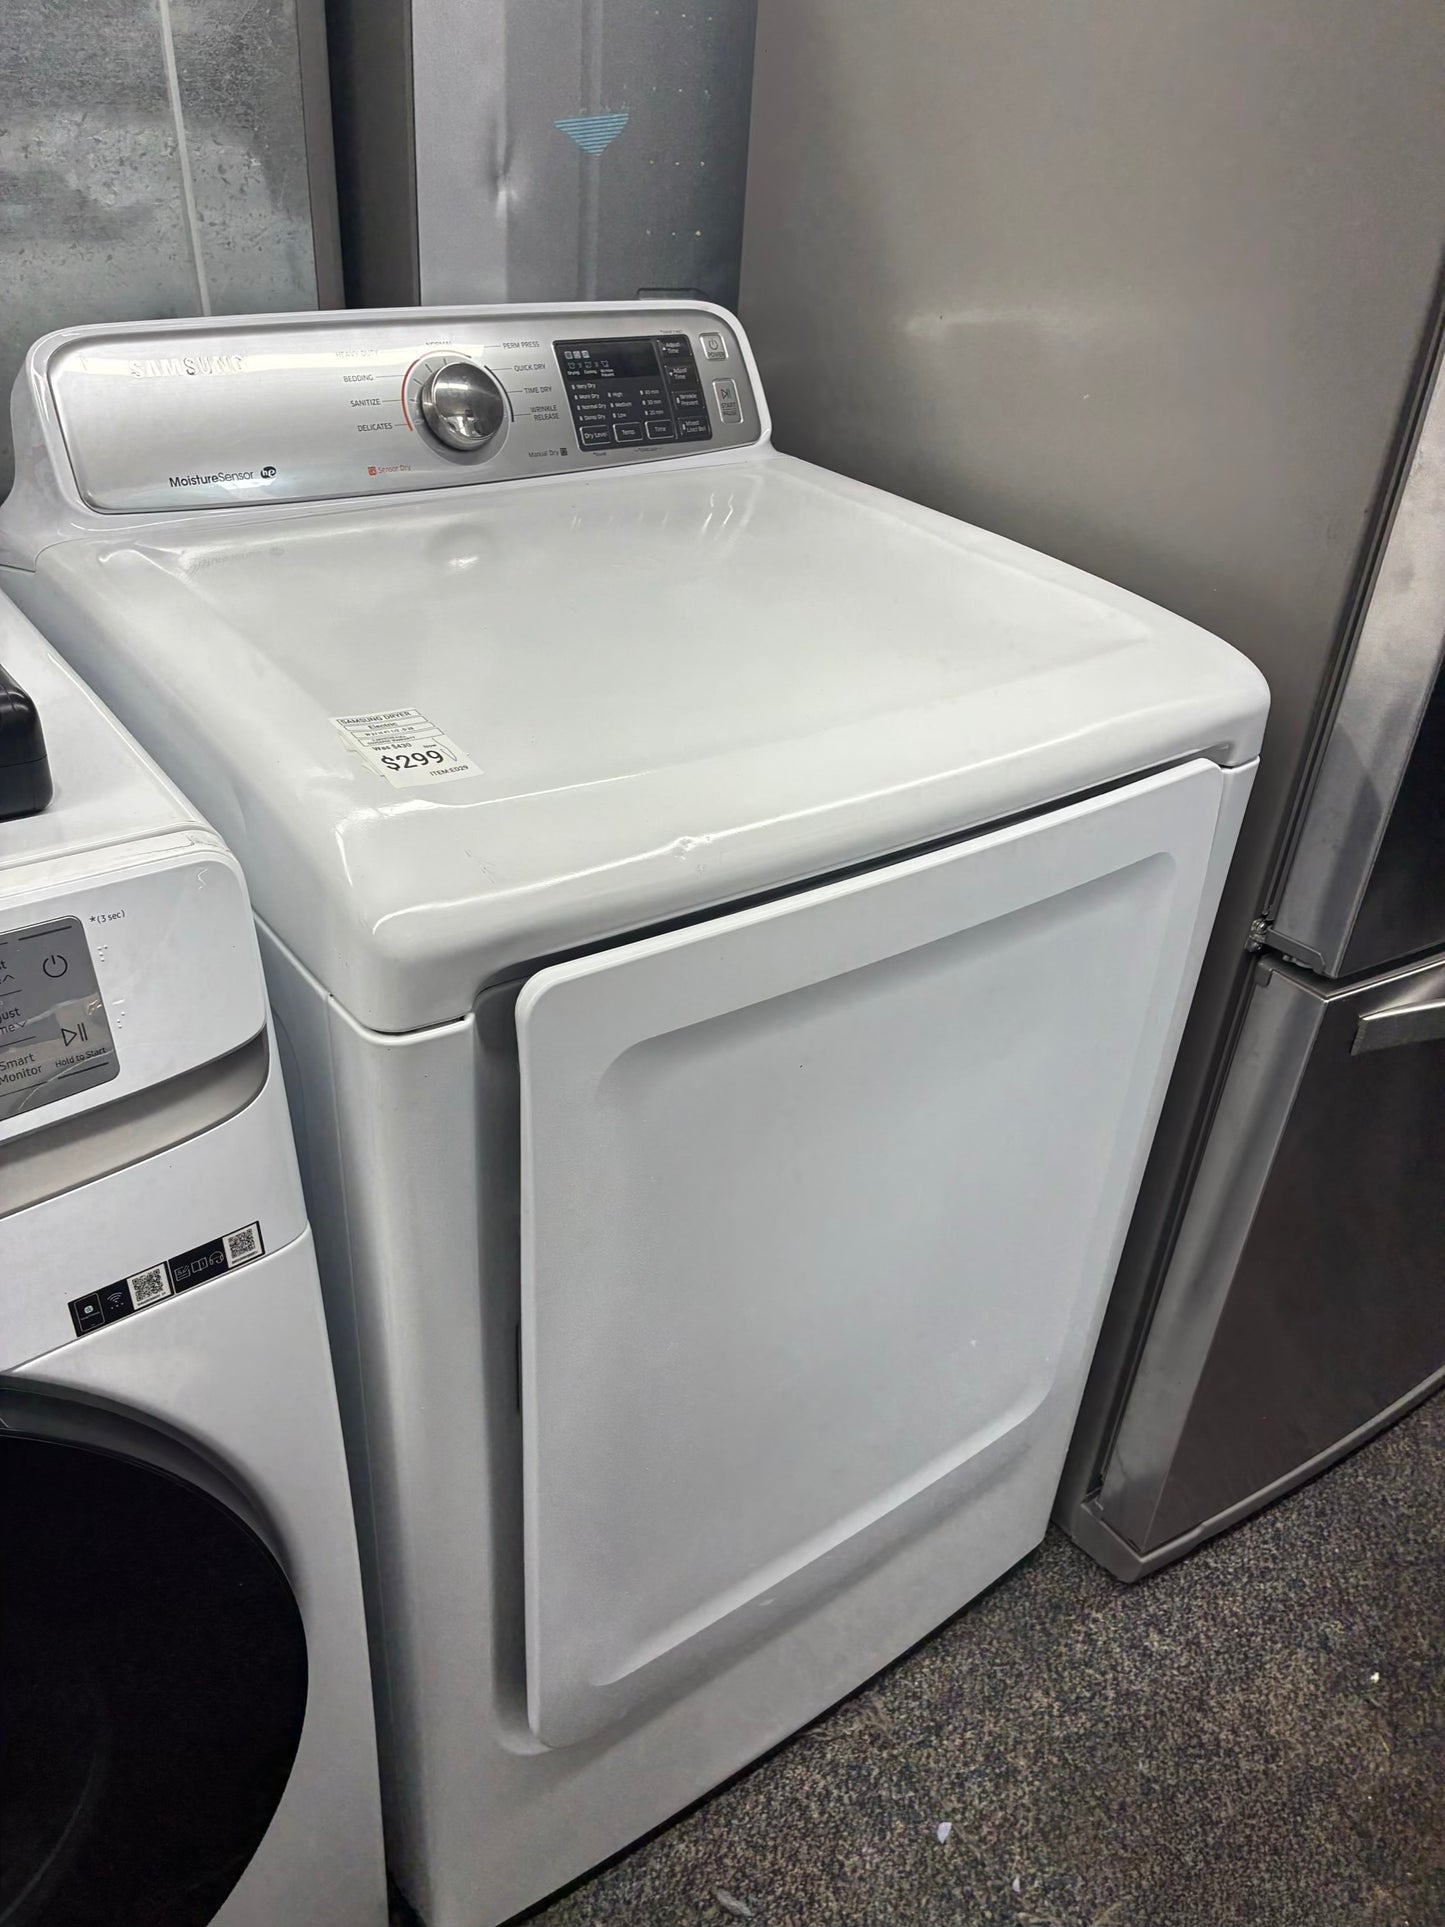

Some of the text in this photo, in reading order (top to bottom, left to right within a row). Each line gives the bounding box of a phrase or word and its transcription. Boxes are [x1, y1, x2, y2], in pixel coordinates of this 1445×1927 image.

[502, 342, 520, 350] PERM
[128, 355, 246, 378] SAMSUNG
[513, 363, 546, 372] QUICK DRY
[343, 374, 374, 383] BEDDING
[350, 398, 382, 407] SANITIZE
[530, 405, 557, 413] WRINKLE
[533, 412, 560, 421] RELEASE
[357, 422, 393, 432] DELICATES
[169, 472, 253, 488] MoistureSensor
[340, 711, 411, 725] SAMSUNG DRYER
[368, 722, 398, 730] Electric
[381, 750, 444, 772] $299
[107, 909, 125, 921] sec)
[0, 1053, 35, 1071] Smart
[55, 1047, 107, 1067] Hold to Start
